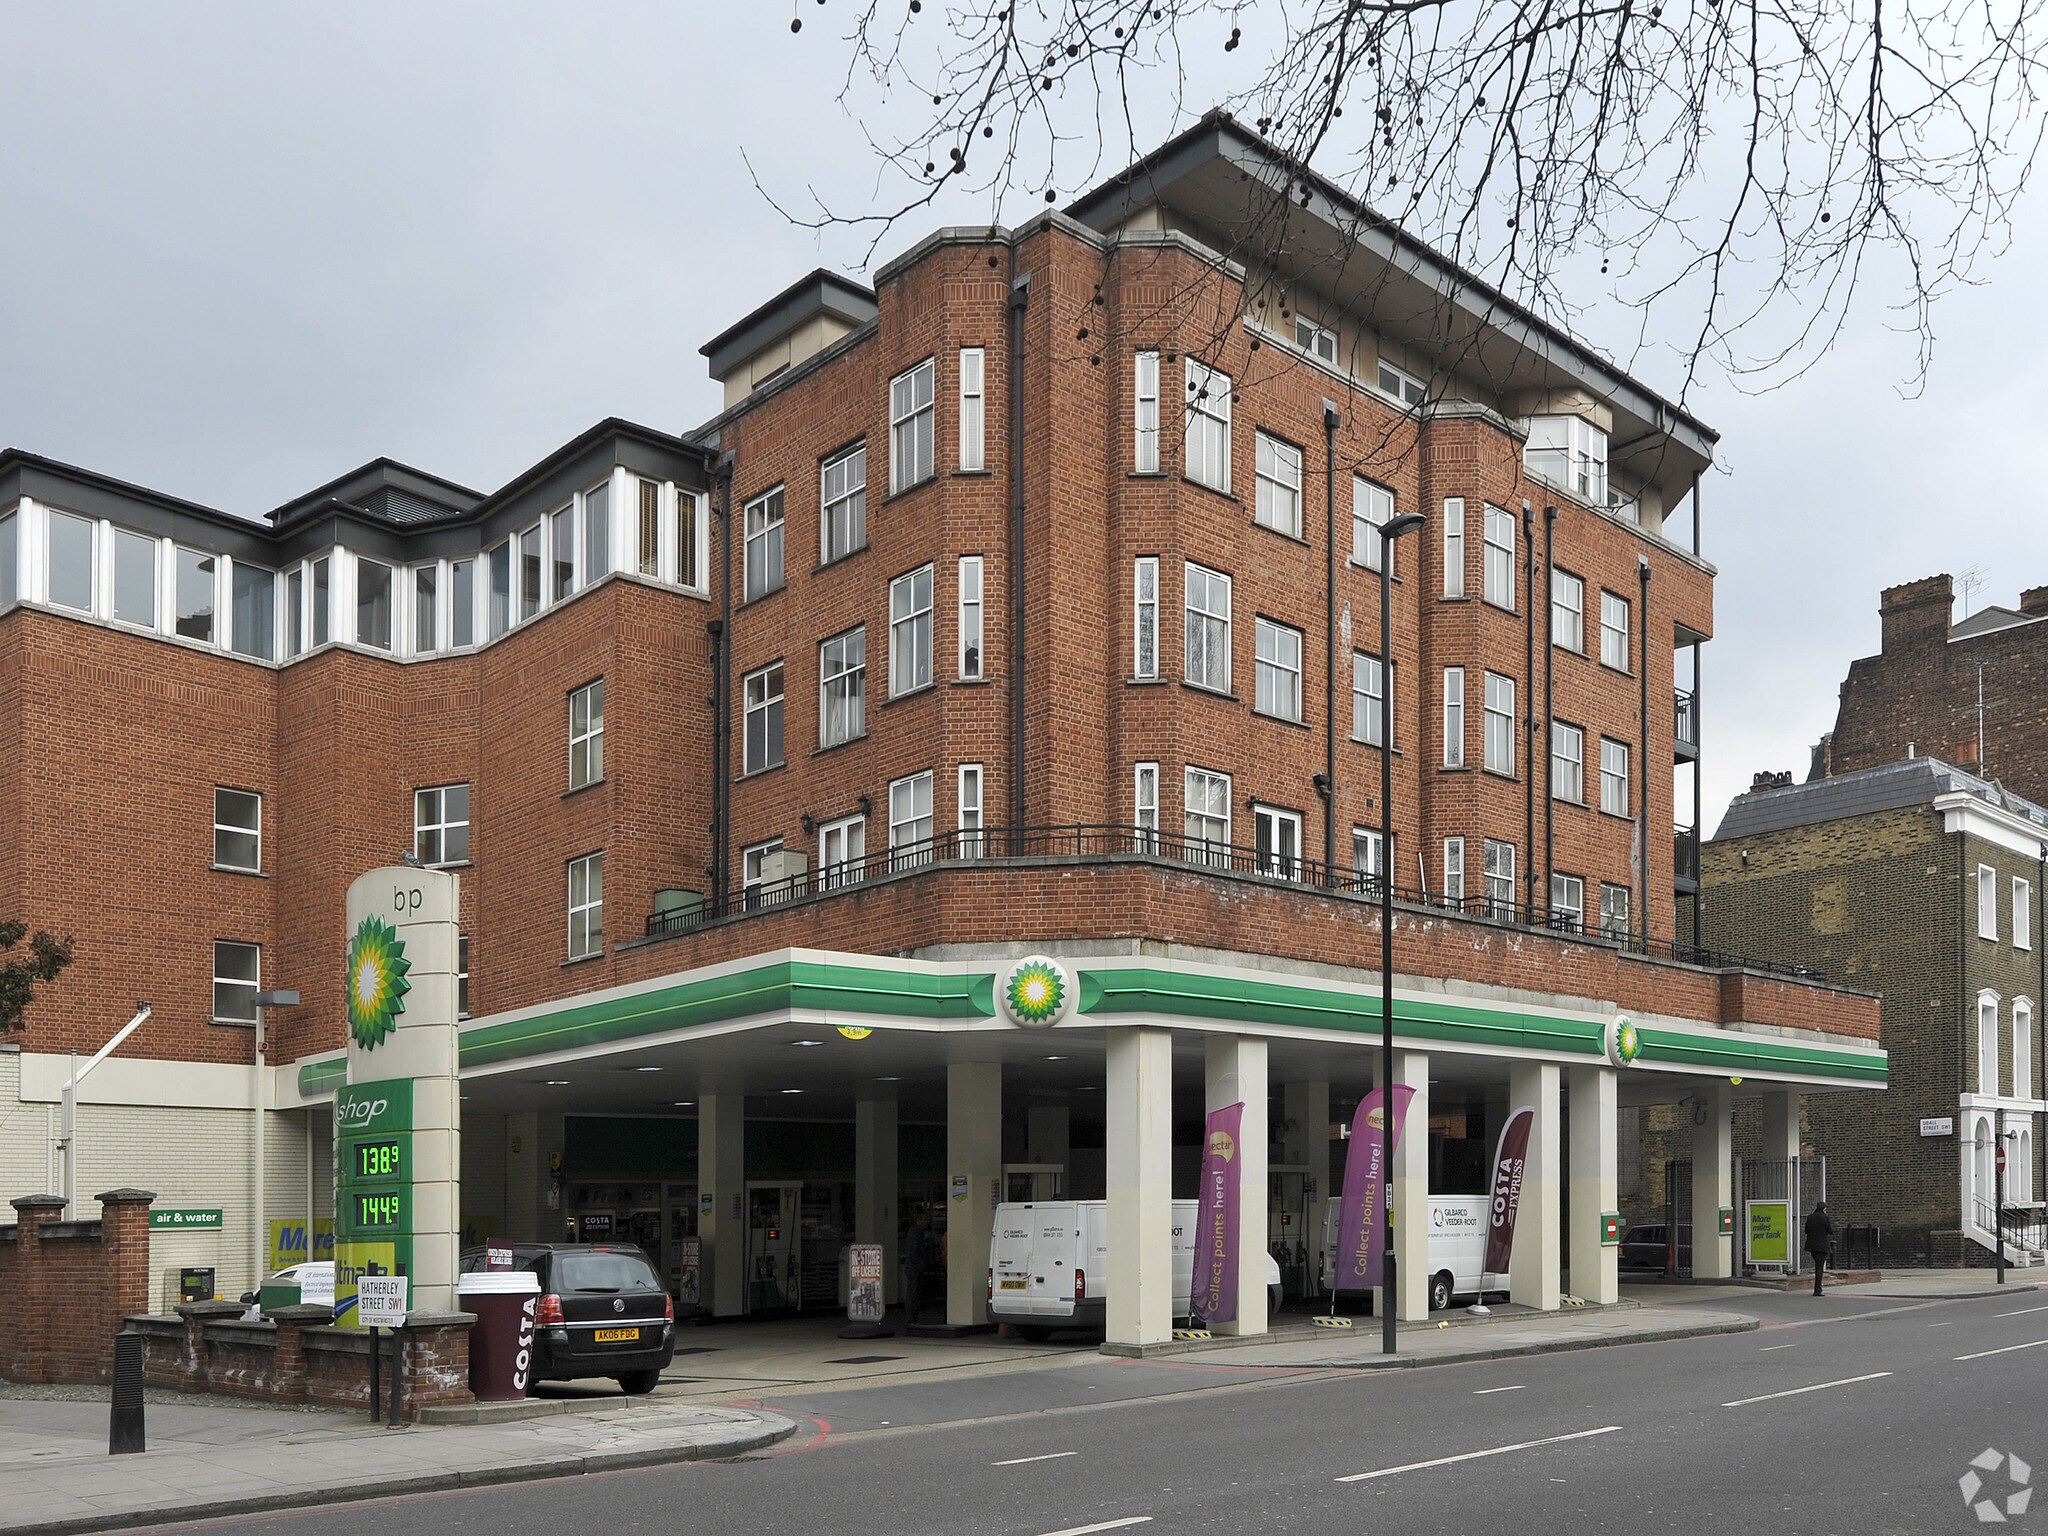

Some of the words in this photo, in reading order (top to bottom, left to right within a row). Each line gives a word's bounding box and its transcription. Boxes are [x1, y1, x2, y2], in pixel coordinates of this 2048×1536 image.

[393, 885, 423, 918] bp
[337, 1094, 387, 1128] shop
[1368, 1115, 1385, 1125] nec
[1211, 1141, 1232, 1150] ectar
[1365, 1142, 1382, 1179] here!
[1212, 1170, 1224, 1208] here!
[1491, 1158, 1513, 1227] COSTA
[1509, 1158, 1523, 1208] EXPRESS
[156, 1213, 171, 1223] air
[173, 1212, 183, 1222] &
[185, 1213, 217, 1222] water
[1361, 1183, 1376, 1226] points
[1752, 1215, 1771, 1223] More
[1212, 1213, 1226, 1257] points
[1752, 1223, 1771, 1231] miles
[1753, 1232, 1764, 1241] per
[1354, 1229, 1370, 1276] Collect
[361, 1282, 400, 1294] HATHERLEY
[361, 1297, 385, 1310] STREET
[388, 1298, 402, 1310] SW1
[1207, 1262, 1222, 1312] Collect
[512, 1296, 537, 1391] COSTA
[598, 1330, 619, 1340] AK06
